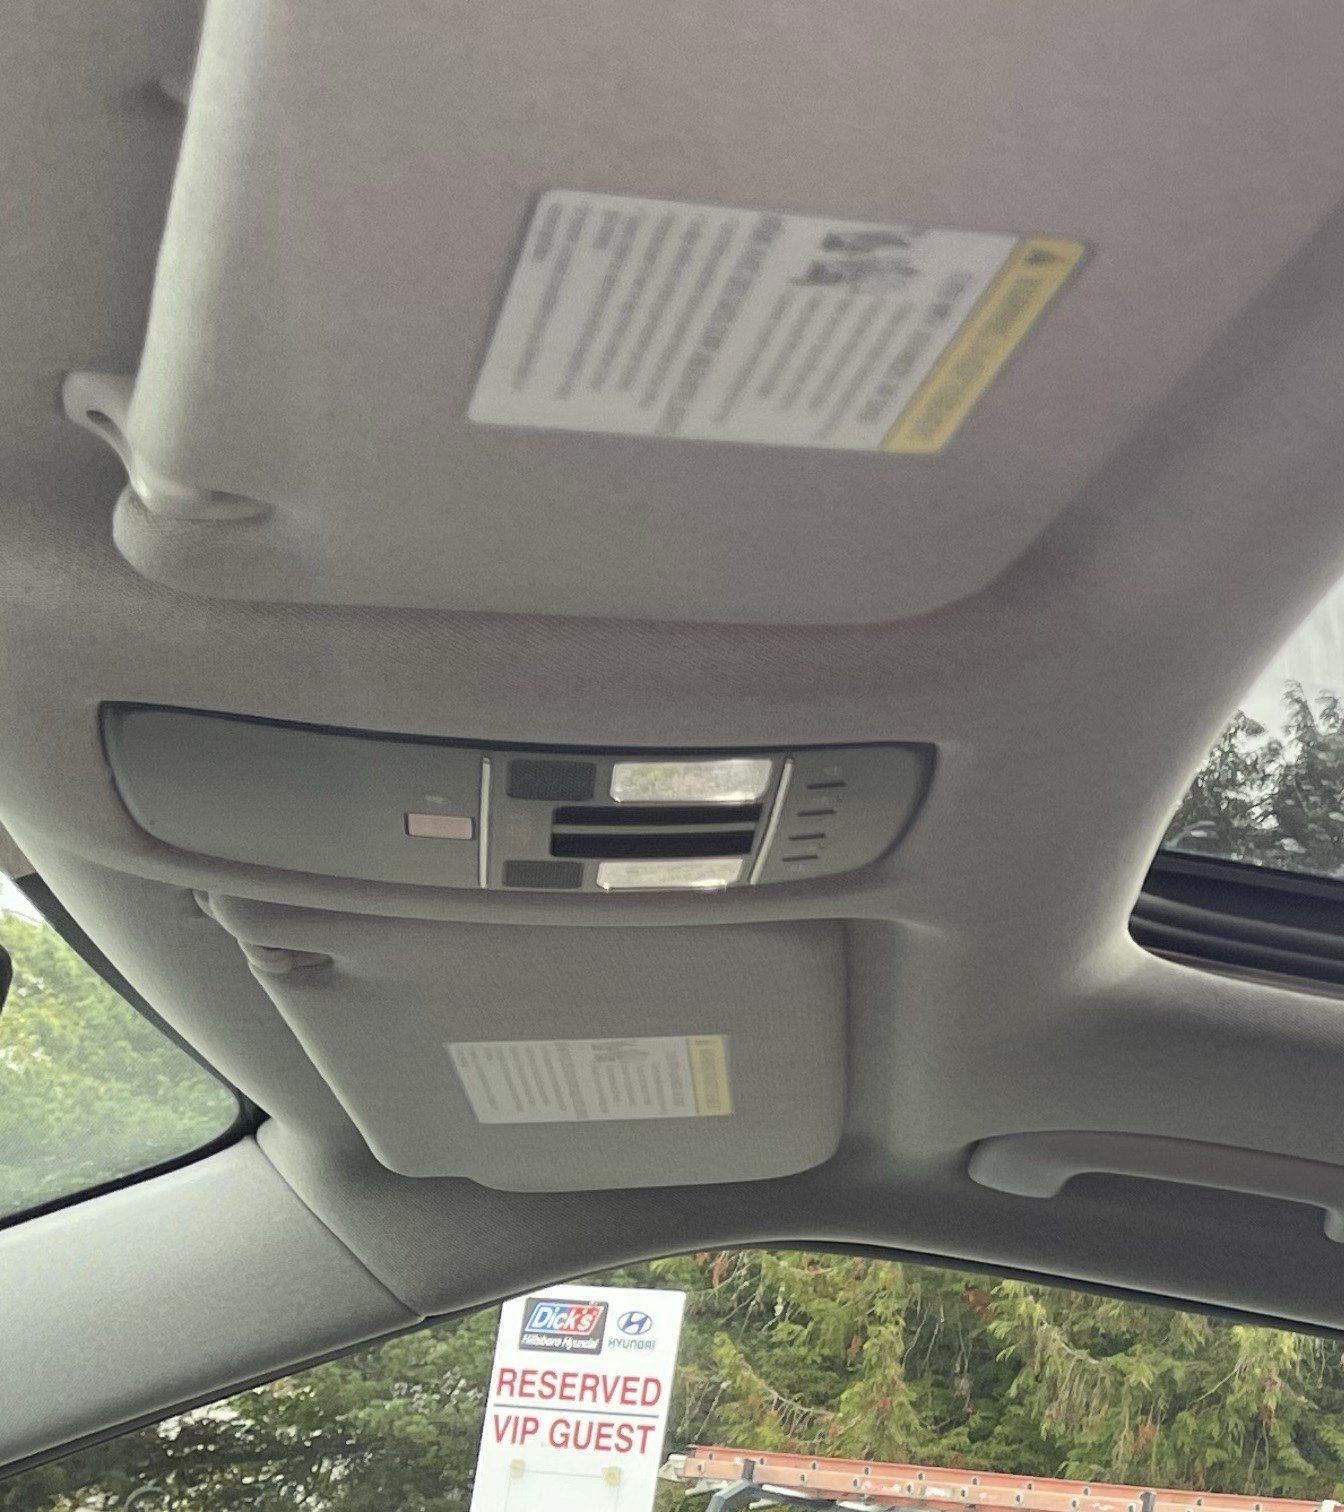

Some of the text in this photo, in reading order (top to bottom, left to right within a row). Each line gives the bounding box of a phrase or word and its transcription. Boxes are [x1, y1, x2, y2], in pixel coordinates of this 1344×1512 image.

[534, 1306, 593, 1332] Dick's
[608, 1338, 656, 1350] HYUNDAI
[496, 1368, 662, 1407] RESERVED
[493, 1414, 656, 1454] VIP GUEST
